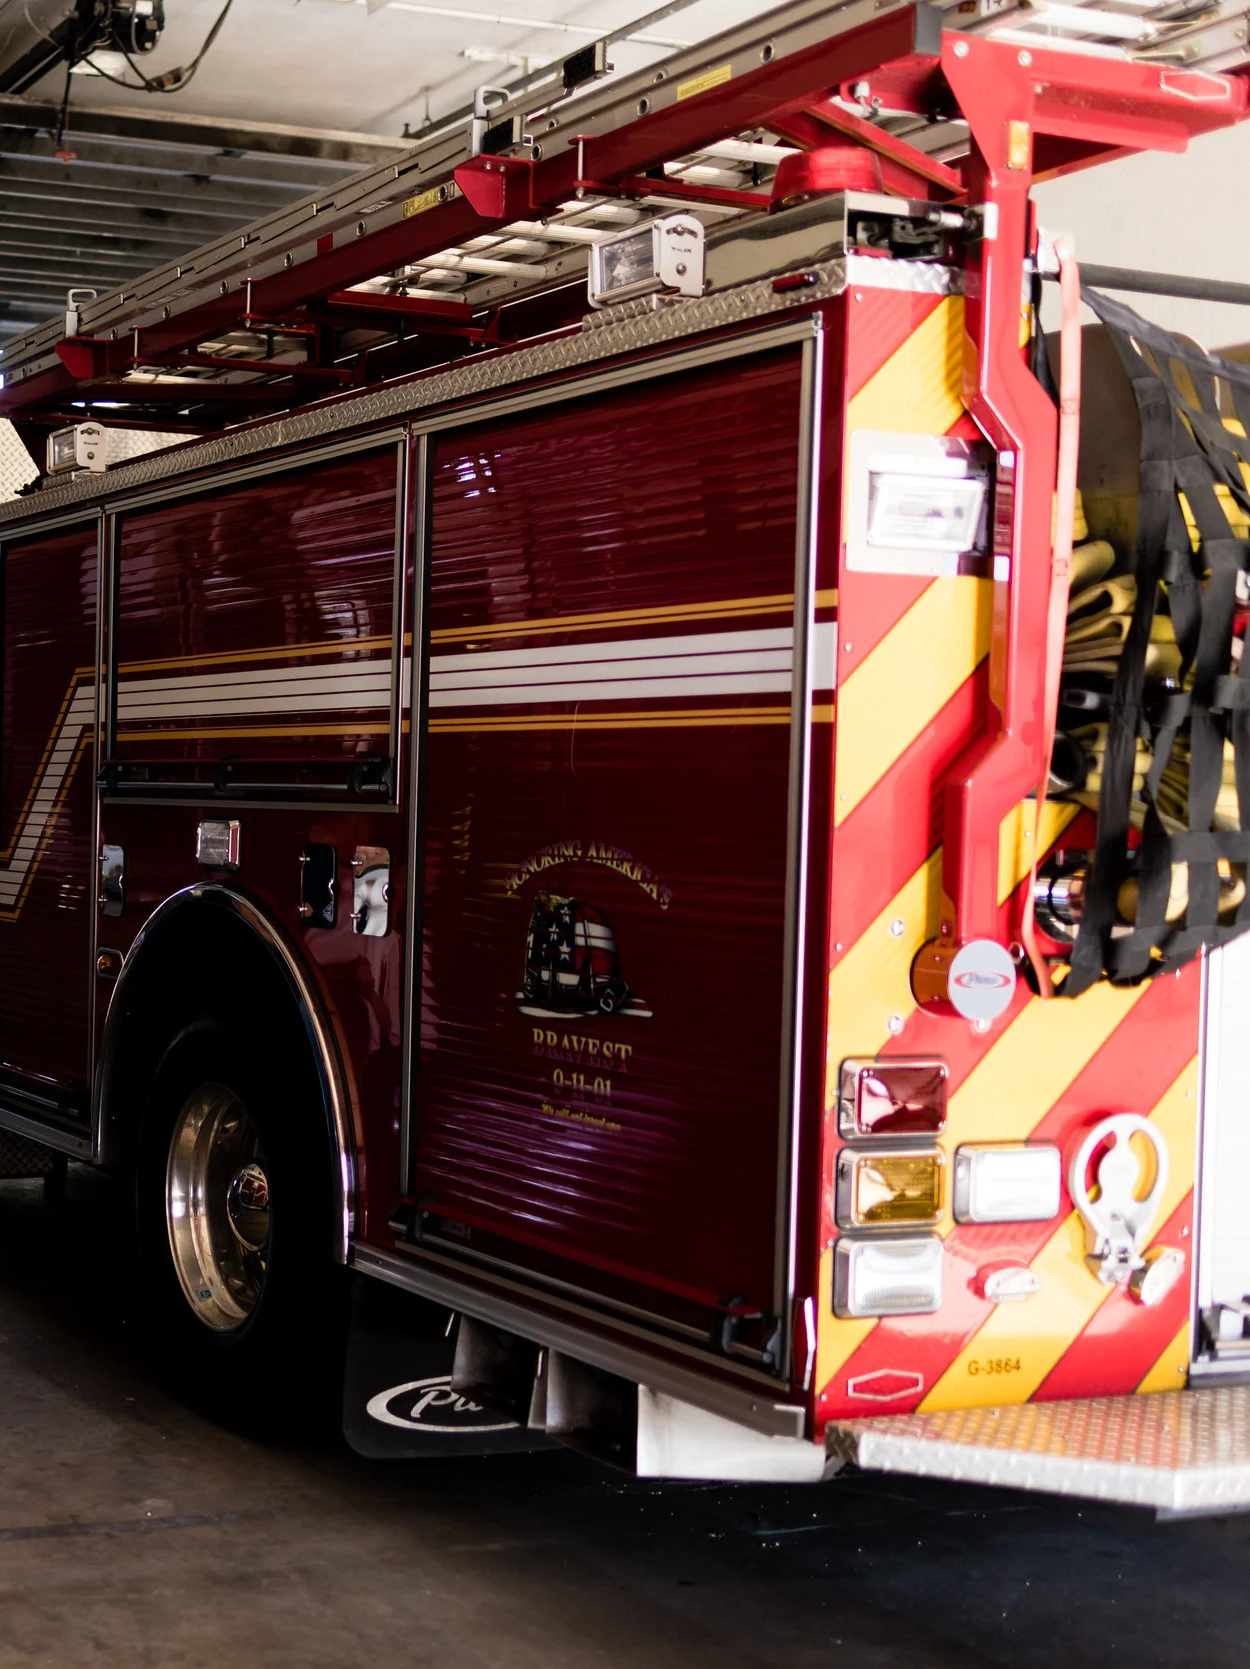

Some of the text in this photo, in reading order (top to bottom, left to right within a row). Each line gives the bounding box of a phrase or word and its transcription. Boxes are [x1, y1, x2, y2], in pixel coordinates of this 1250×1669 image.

[503, 839, 583, 896] HONORING
[531, 1027, 633, 1074] BRAVEST
[967, 1357, 1021, 1376] G-3864
